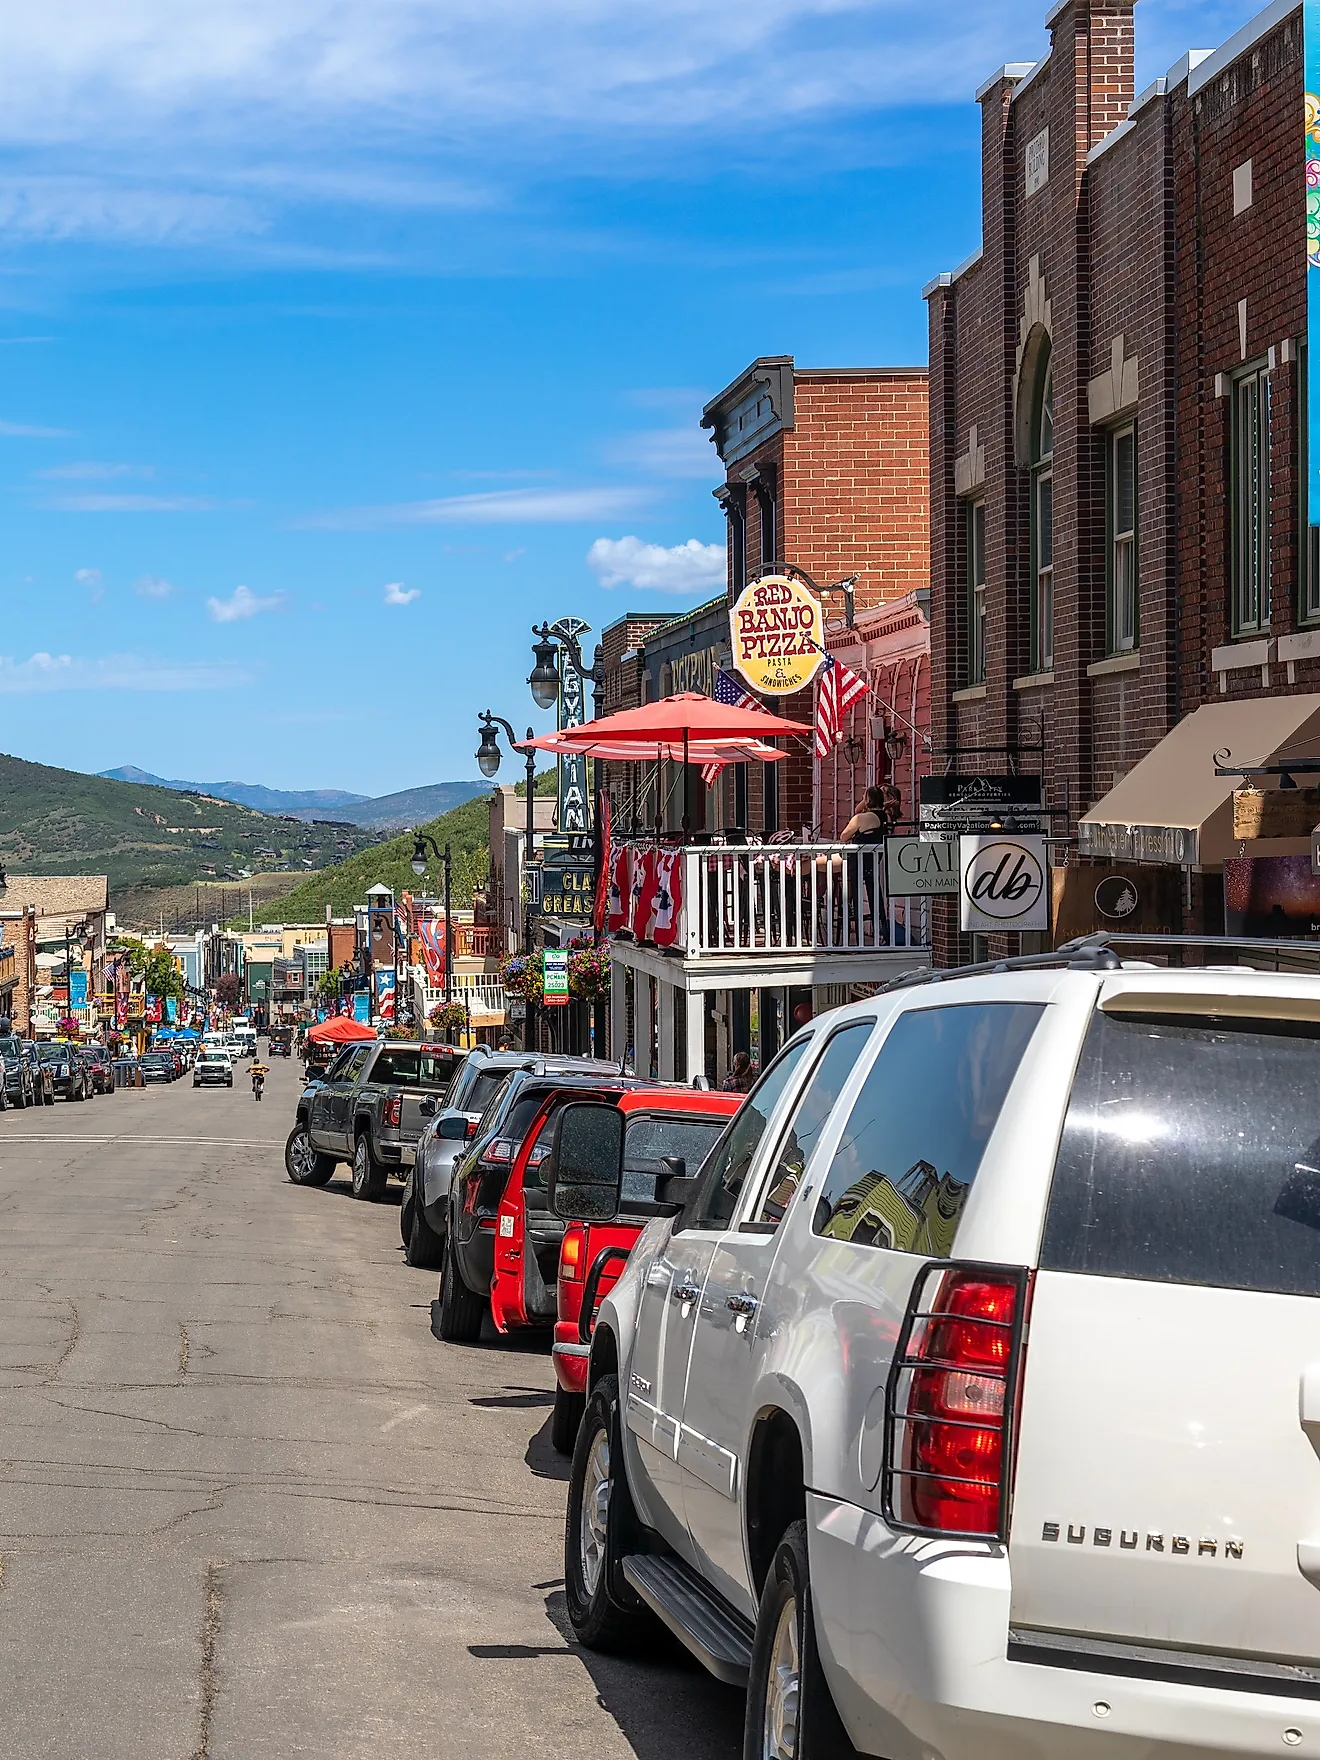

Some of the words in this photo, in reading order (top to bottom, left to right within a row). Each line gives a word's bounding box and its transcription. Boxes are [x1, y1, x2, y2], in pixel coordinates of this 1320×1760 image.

[754, 583, 792, 607] RED
[738, 604, 814, 634] BANJO
[740, 630, 816, 660] PIZZA
[671, 645, 715, 698] EGYPTIA
[767, 657, 792, 667] PASTA
[775, 667, 786, 679] &
[760, 673, 802, 688] SANDWICHES
[971, 852, 1039, 901] db
[543, 894, 594, 914] GREAS
[1041, 1521, 1244, 1560] SUBURBAN
